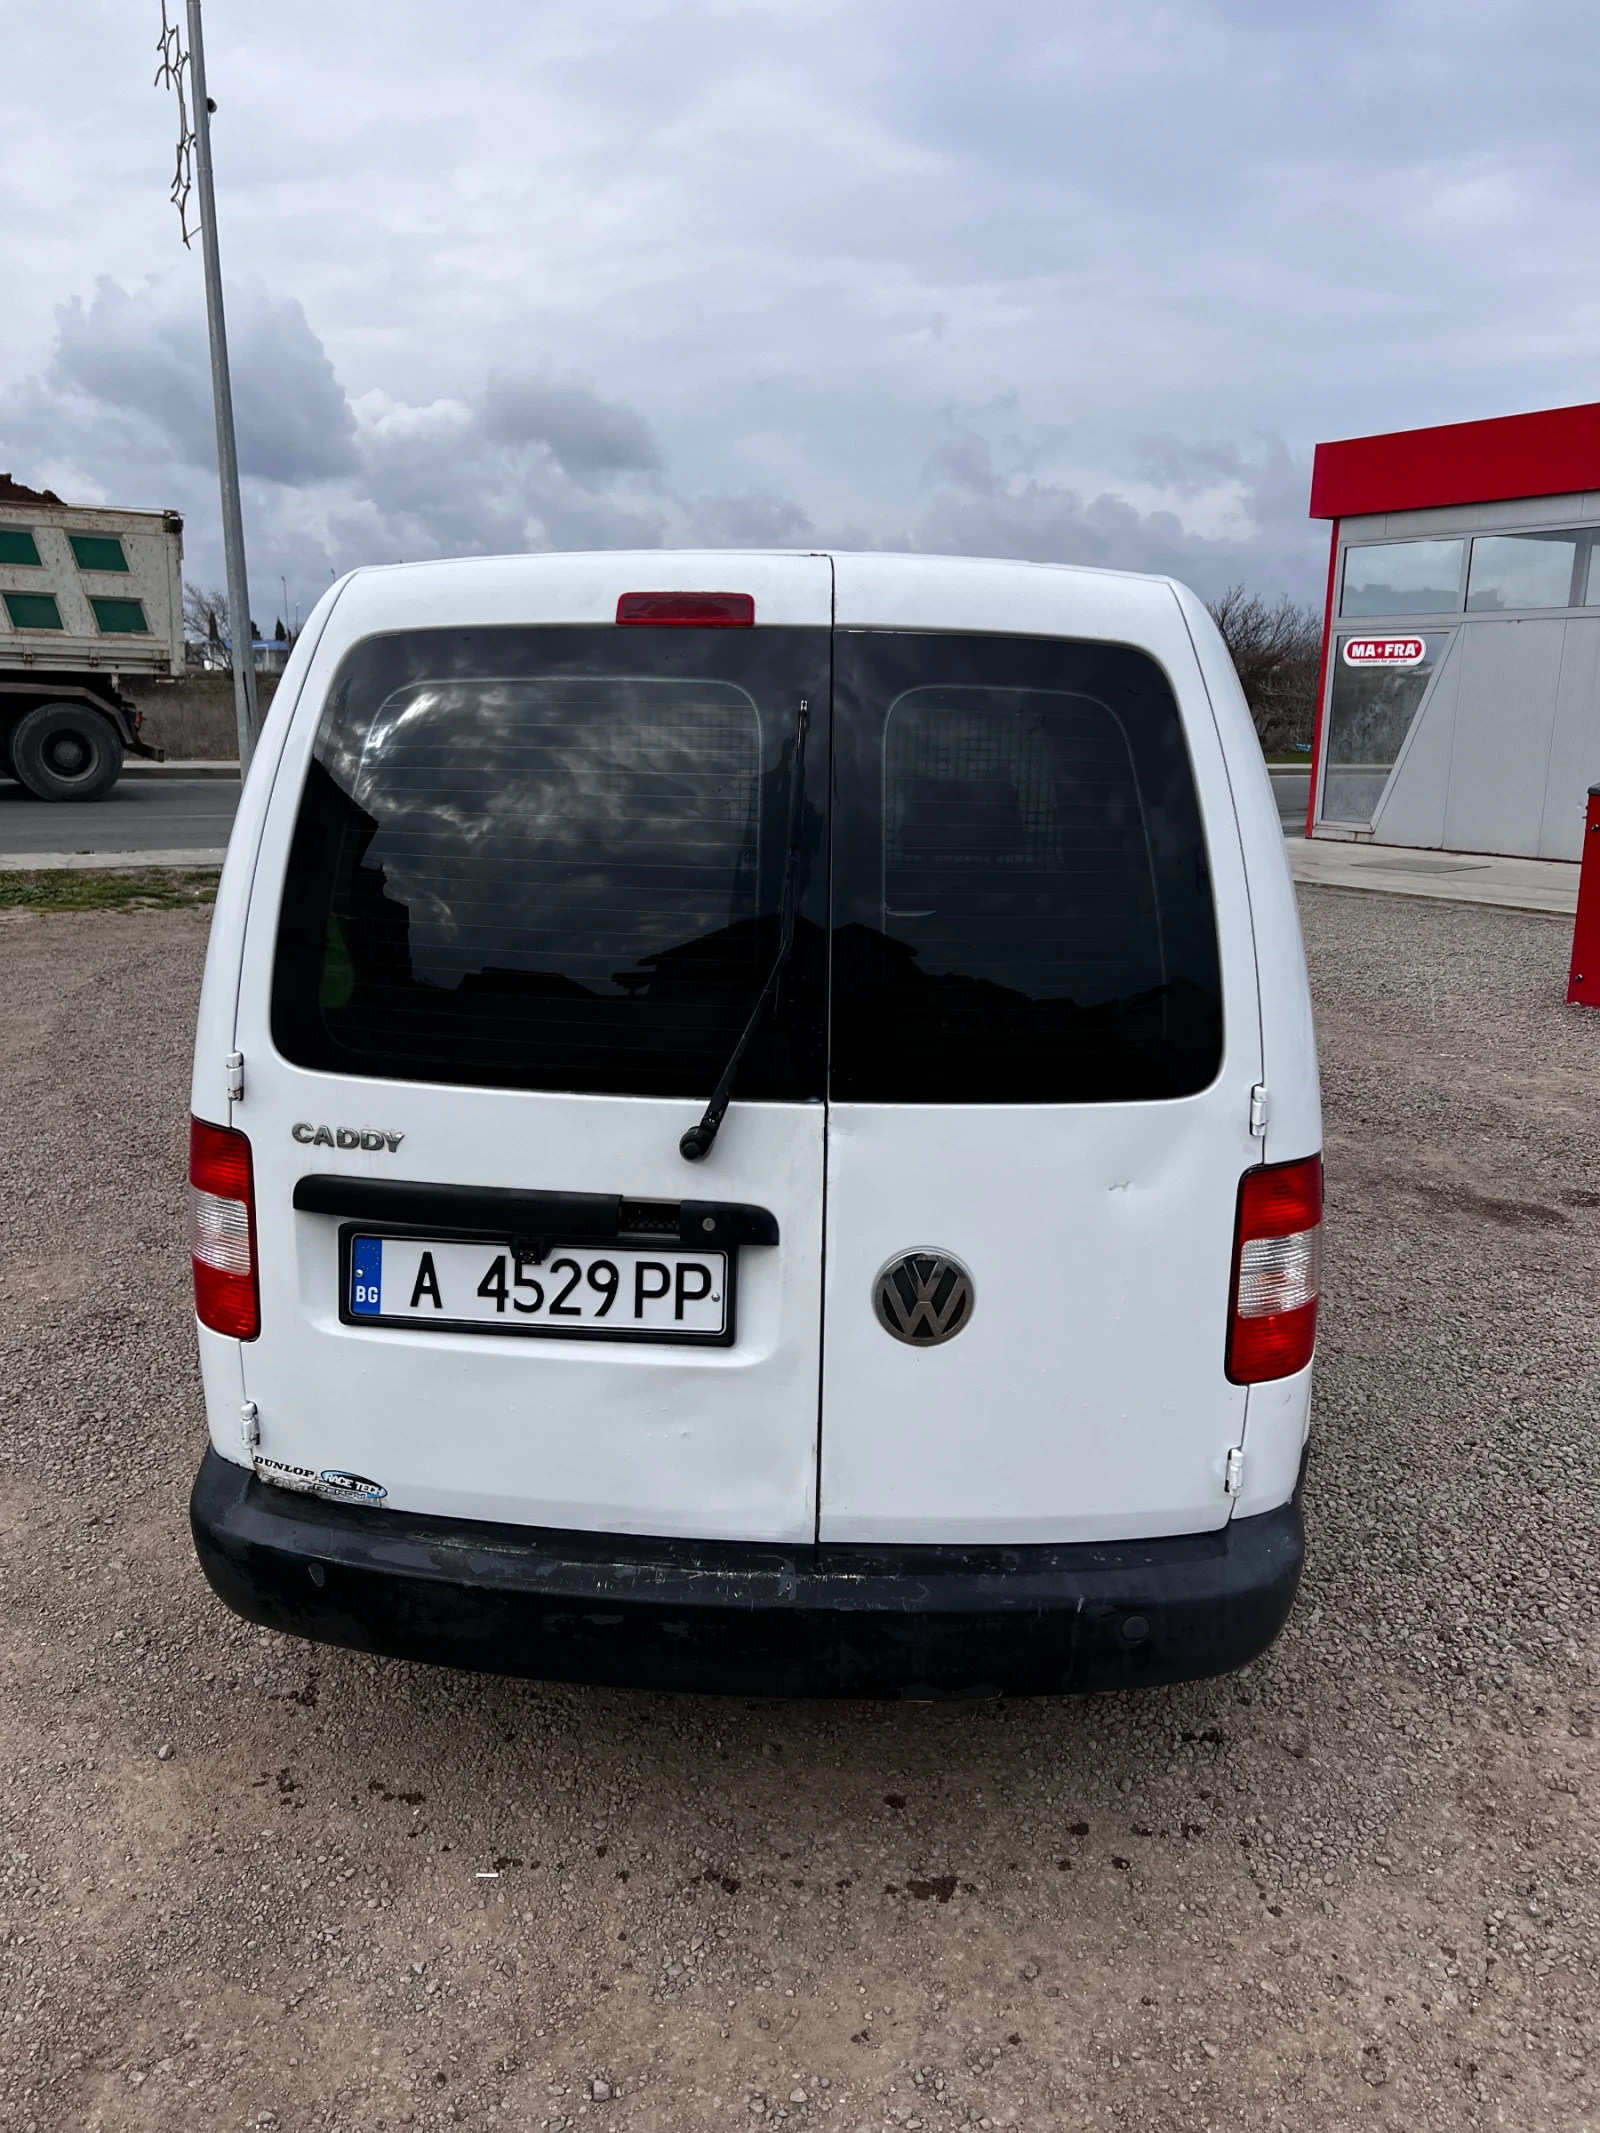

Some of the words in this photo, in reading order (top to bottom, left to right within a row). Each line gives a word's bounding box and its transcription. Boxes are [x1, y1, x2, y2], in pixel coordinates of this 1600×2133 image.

[292, 1121, 405, 1153] CADDY
[355, 1286, 378, 1303] BG
[410, 1251, 442, 1308] A
[634, 1261, 712, 1320] PP
[254, 1455, 315, 1477] DUNLOP
[326, 1474, 354, 1489] RACE
[355, 1481, 386, 1496] TECH
